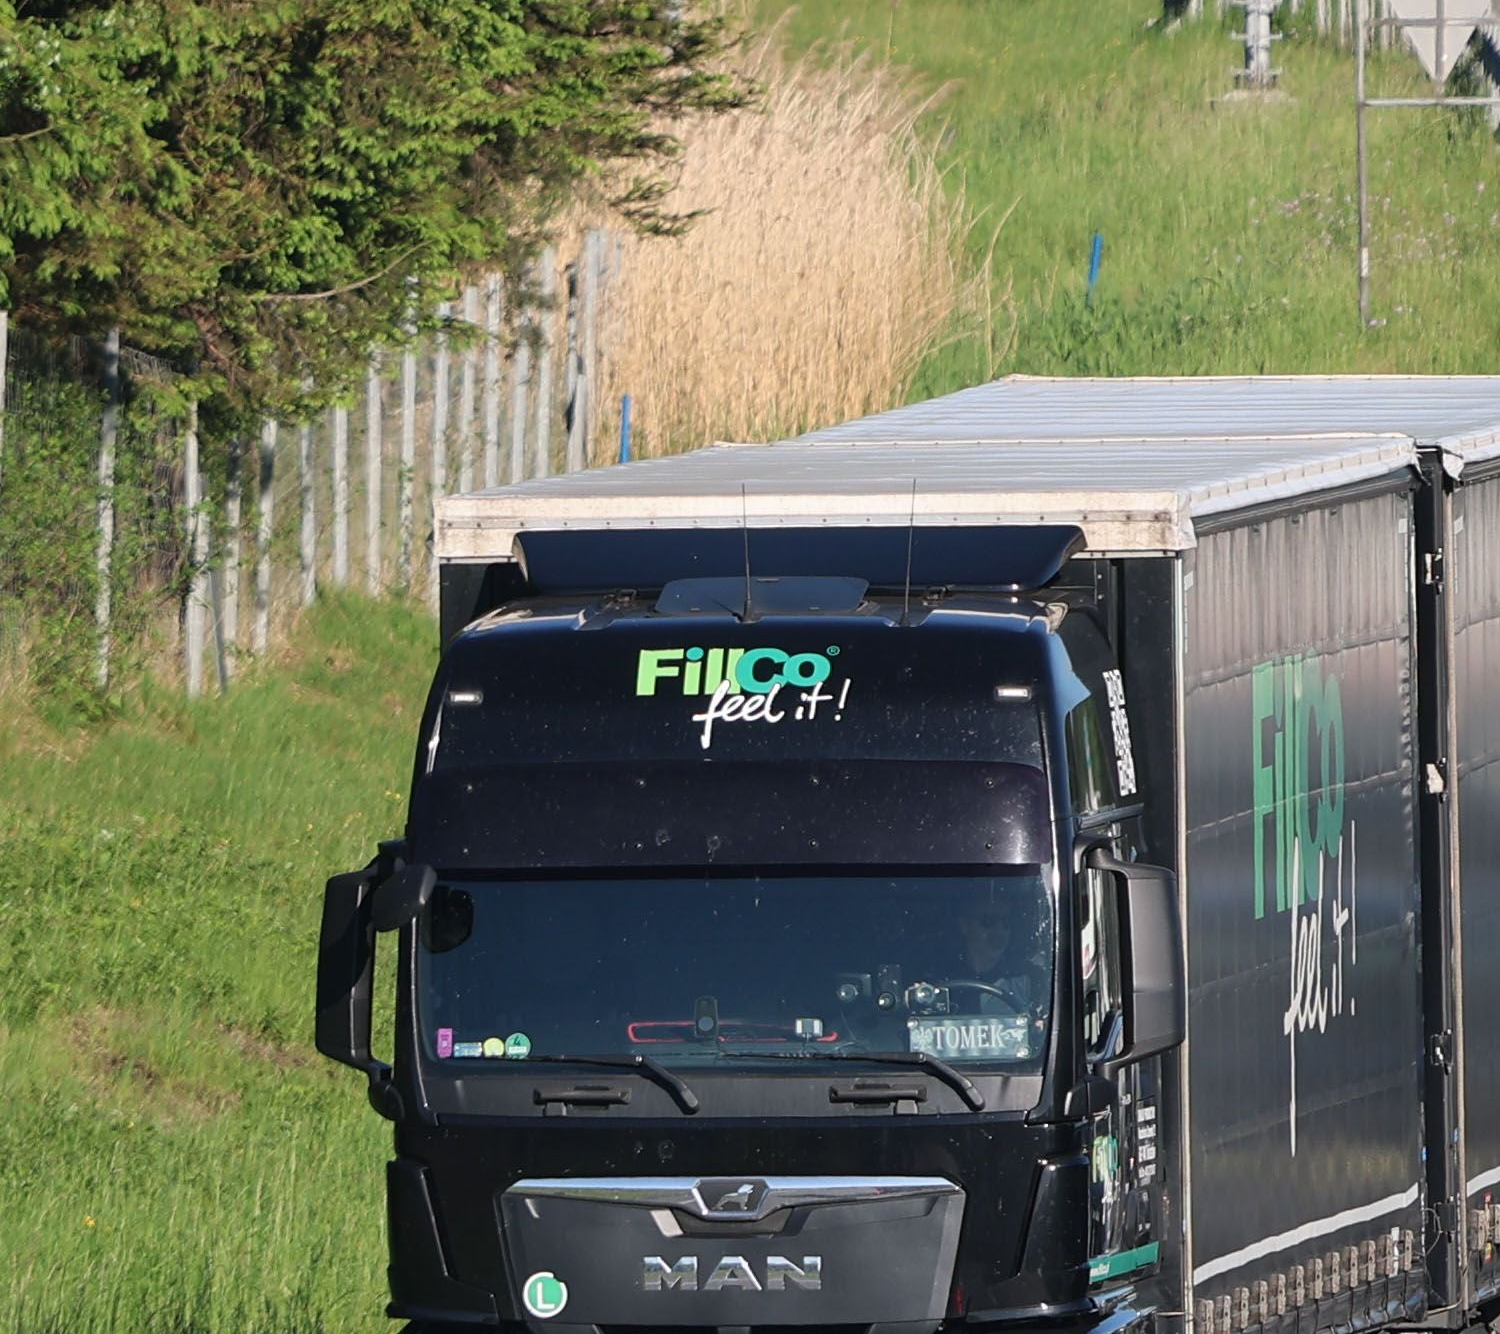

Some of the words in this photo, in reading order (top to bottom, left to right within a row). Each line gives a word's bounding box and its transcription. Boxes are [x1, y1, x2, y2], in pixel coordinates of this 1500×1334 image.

[692, 679, 786, 750] feel
[931, 1024, 1007, 1050] TOMEK
[642, 1255, 822, 1292] MAN
[536, 1281, 556, 1310] L
